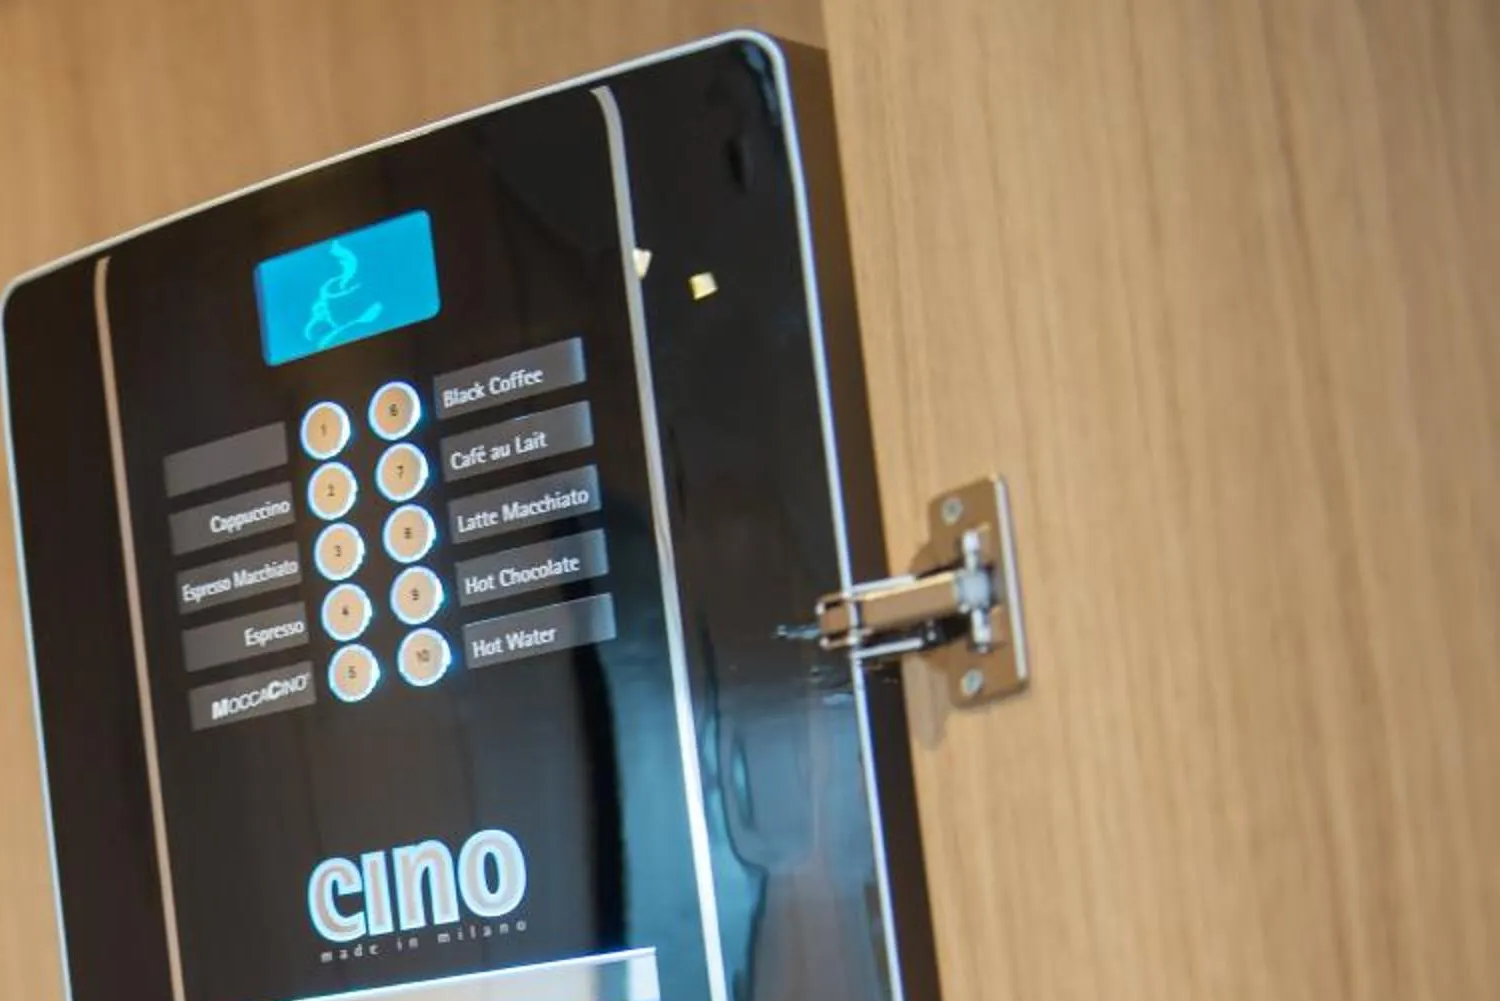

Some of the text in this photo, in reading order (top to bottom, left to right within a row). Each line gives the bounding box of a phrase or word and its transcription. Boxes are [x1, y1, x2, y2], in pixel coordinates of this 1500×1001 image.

[442, 369, 544, 408] Black Coffee
[451, 431, 548, 470] Café au Lait
[210, 500, 291, 533] Cappuccino
[457, 489, 589, 533] Latte Macchiato
[182, 560, 299, 603] Espresso Macchiato
[464, 557, 581, 595] Hot Chocolate
[244, 621, 305, 648] Espresso
[471, 627, 558, 659] Hot Water
[320, 920, 527, 963] made in milano
